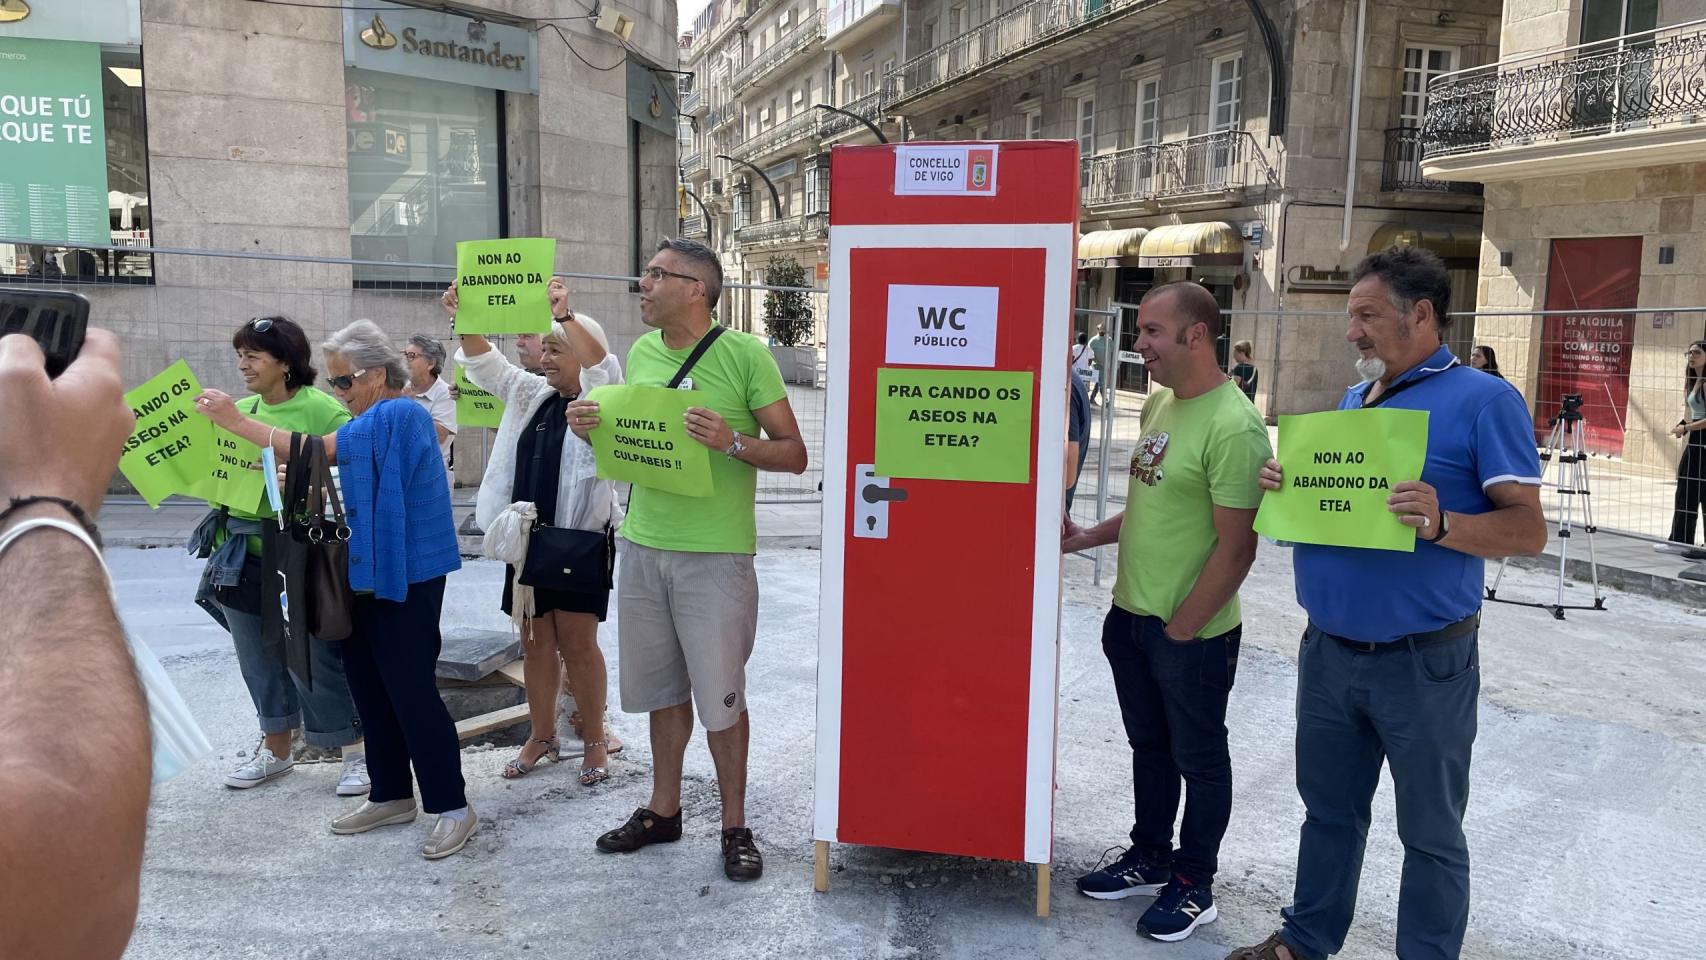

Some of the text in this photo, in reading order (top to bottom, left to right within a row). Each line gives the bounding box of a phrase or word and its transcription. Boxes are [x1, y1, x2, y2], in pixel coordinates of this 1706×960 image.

[402, 27, 525, 71] Santander
[59, 94, 91, 118] TÚ
[62, 124, 92, 144] TE
[909, 158, 960, 168] CONCELLO
[914, 171, 954, 181] DE VIGO
[478, 253, 522, 265] NON AO
[461, 273, 543, 287] ABANDONO DA
[488, 295, 516, 306] ETEA
[917, 306, 967, 331] WC
[1566, 317, 1623, 327] SE ALQUILA
[914, 334, 968, 347] PÚBLICO
[1564, 329, 1622, 340] EDIFICIO
[1564, 341, 1620, 353] COMPLETO
[171, 379, 191, 396] OS
[888, 385, 1021, 401] PRA CANDO OS
[474, 402, 495, 410] ETEA
[168, 410, 188, 428] NA
[908, 409, 997, 424] ASEOS NA
[615, 418, 666, 432] XUNTA E
[615, 434, 674, 451] CONCELLO
[924, 433, 980, 447] ETEA?
[145, 435, 192, 467] ETEA?
[1313, 452, 1364, 464] NON AO
[613, 450, 672, 468] CULPABEIS
[1293, 476, 1389, 489] ABANDONO DA
[1319, 500, 1351, 512] ETEA
